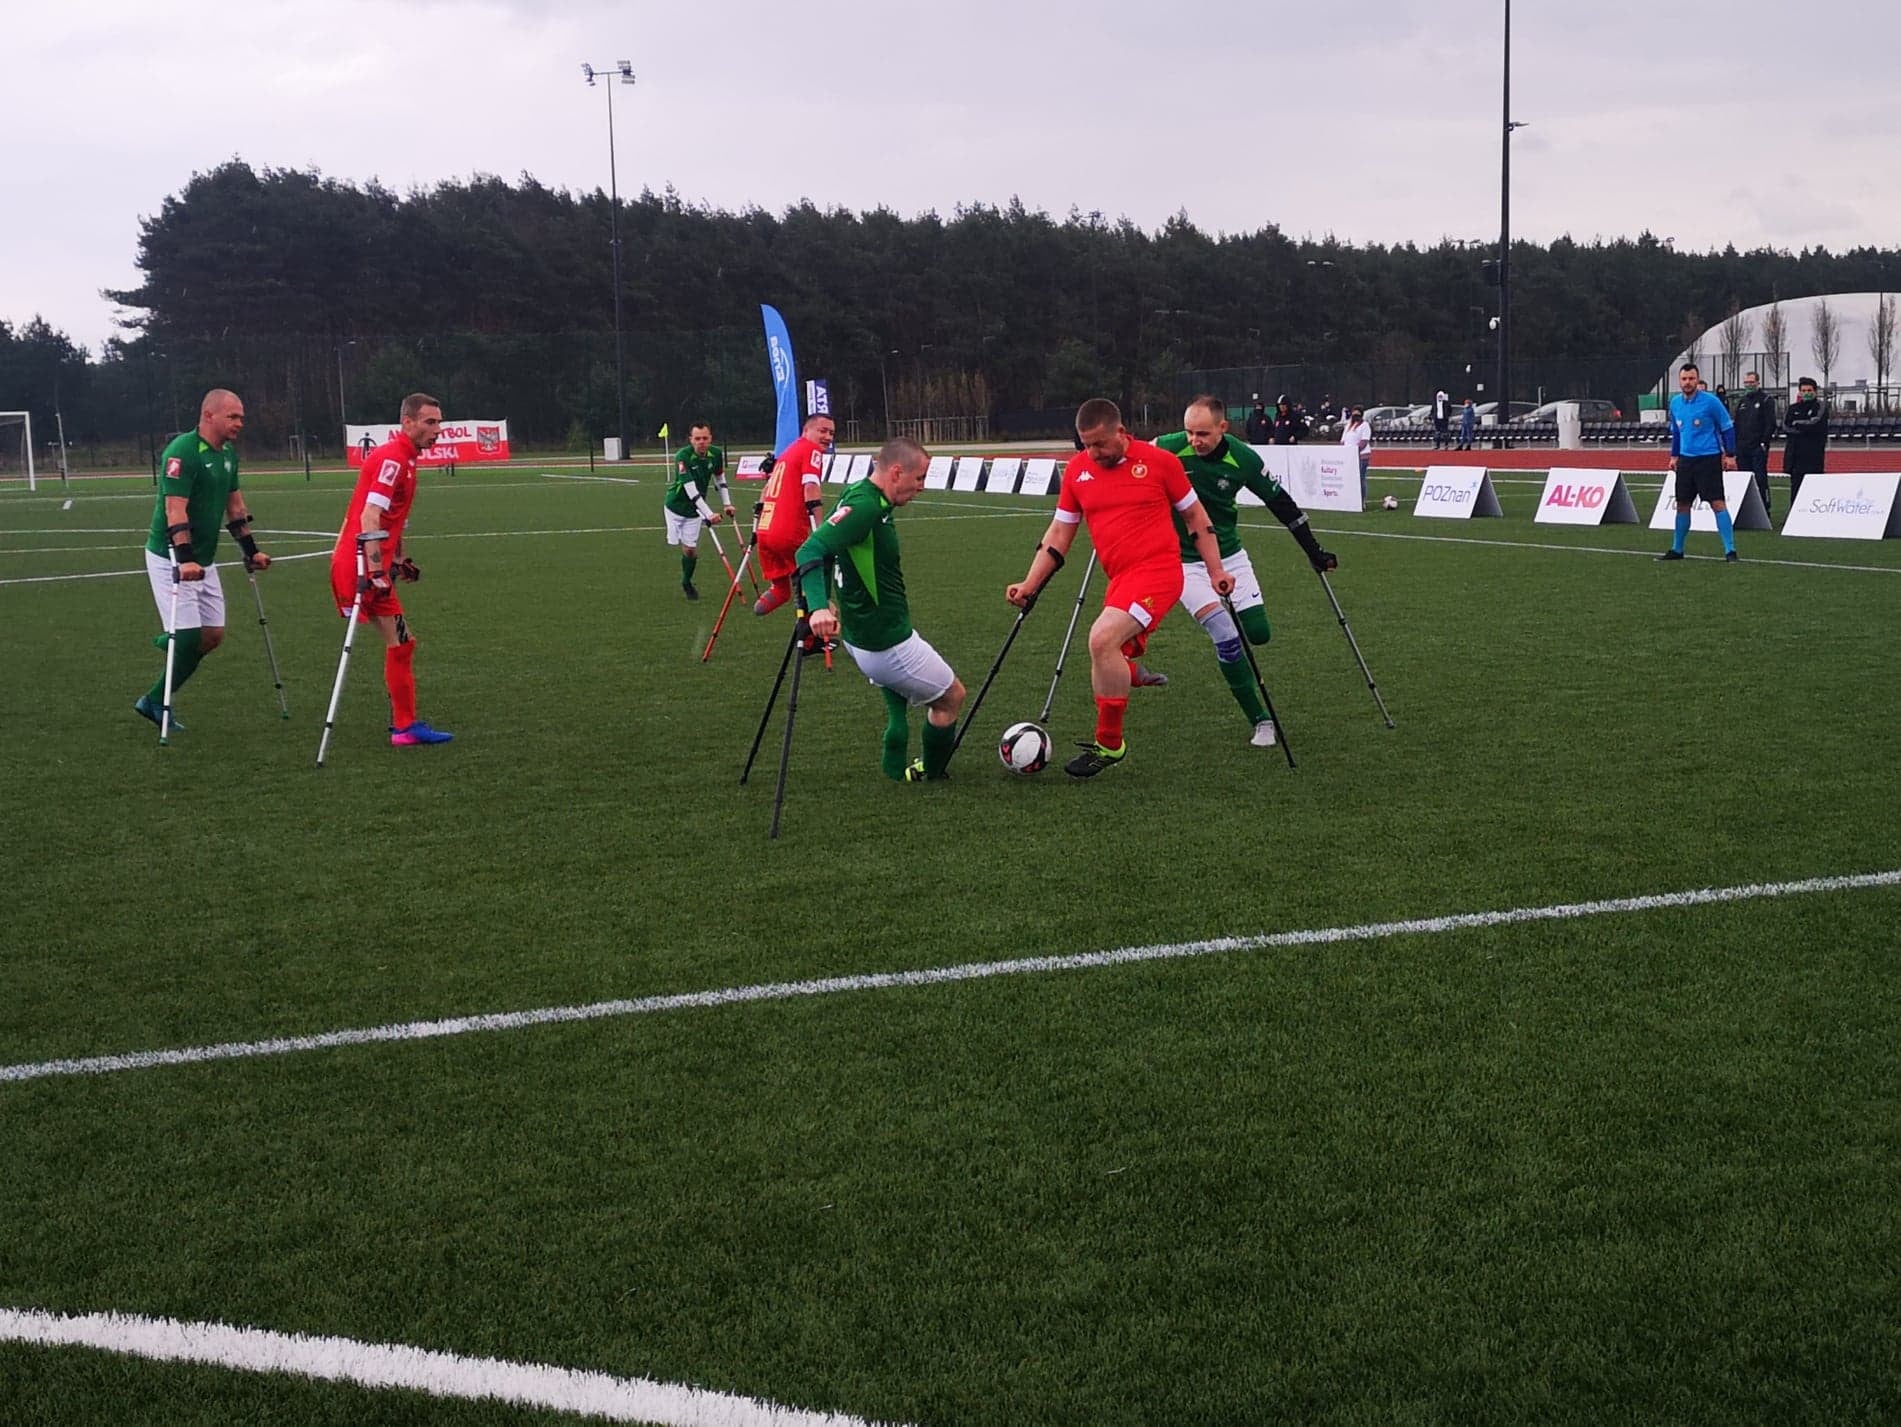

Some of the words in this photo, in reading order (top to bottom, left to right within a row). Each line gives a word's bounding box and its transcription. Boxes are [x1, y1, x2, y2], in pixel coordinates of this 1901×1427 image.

[440, 425, 472, 439] TBOL
[417, 446, 460, 459] OLSKA
[1545, 484, 1605, 508] AL-KO
